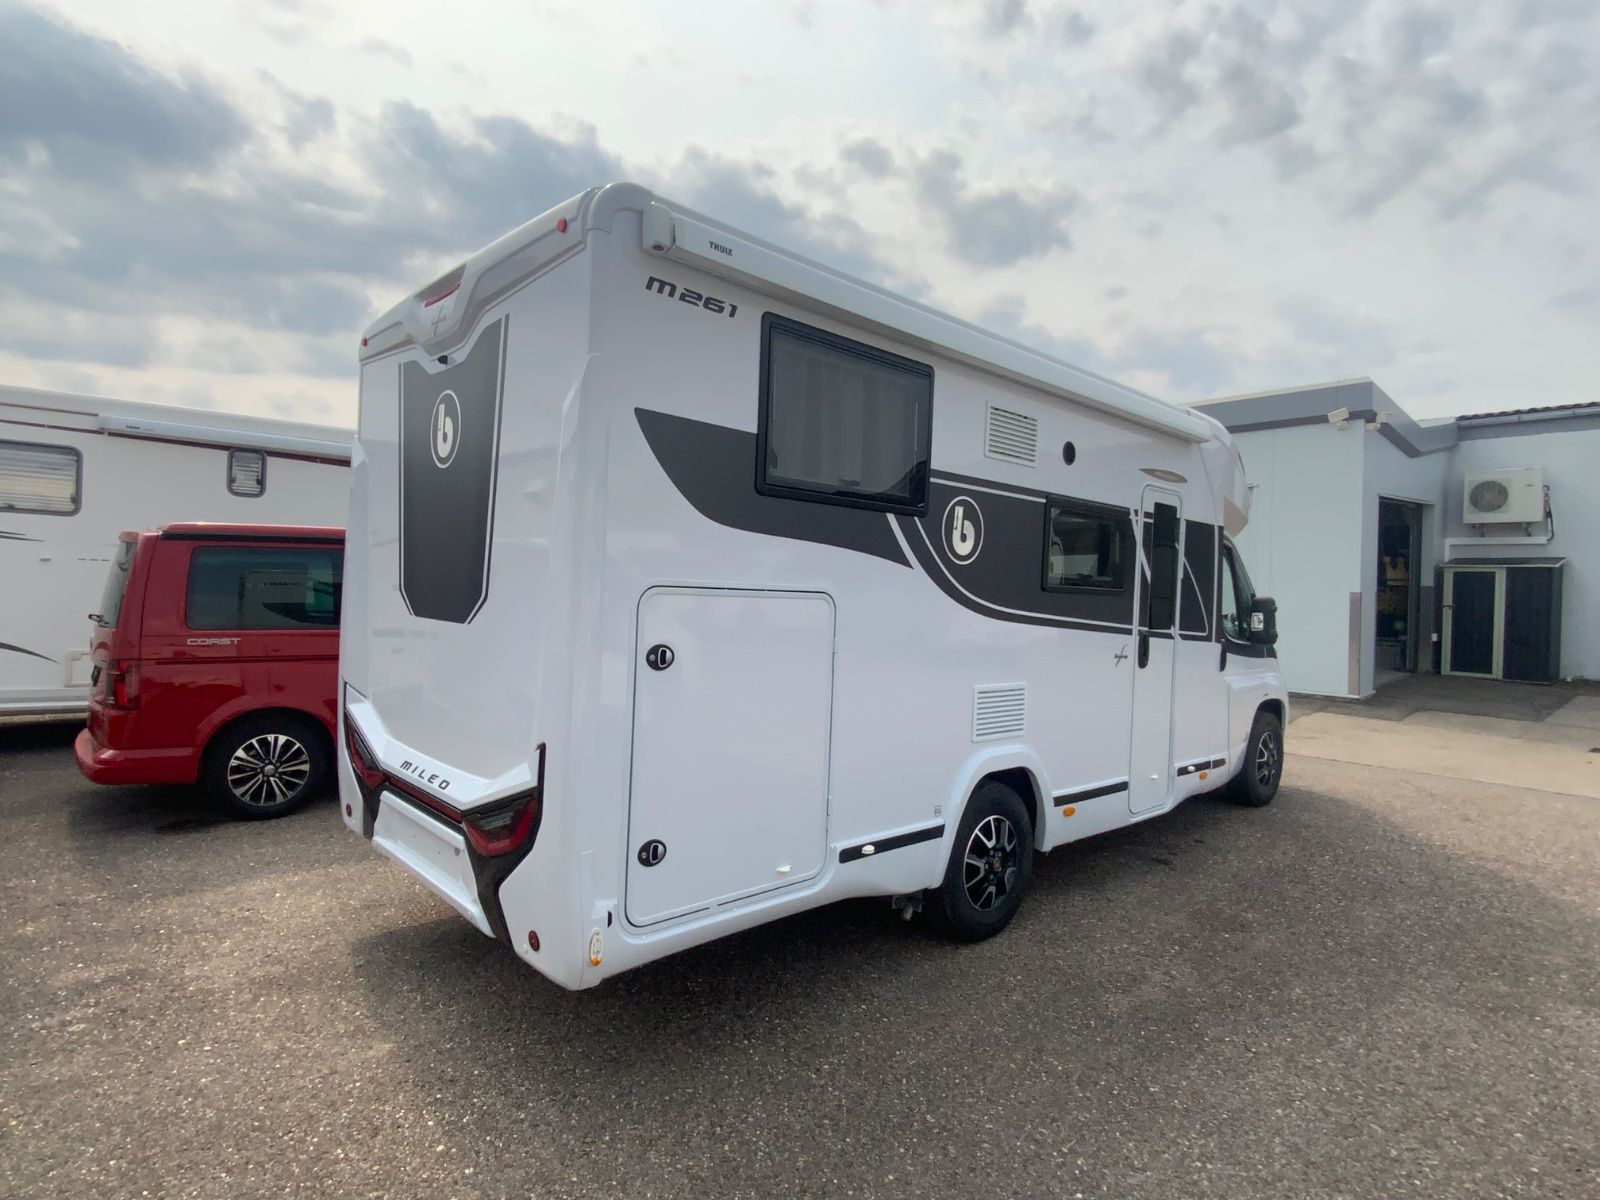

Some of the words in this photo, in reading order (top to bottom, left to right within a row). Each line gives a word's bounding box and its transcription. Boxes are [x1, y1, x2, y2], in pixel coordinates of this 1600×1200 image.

[708, 240, 733, 257] THULE
[186, 637, 241, 646] COAST
[400, 760, 450, 790] MILEO
